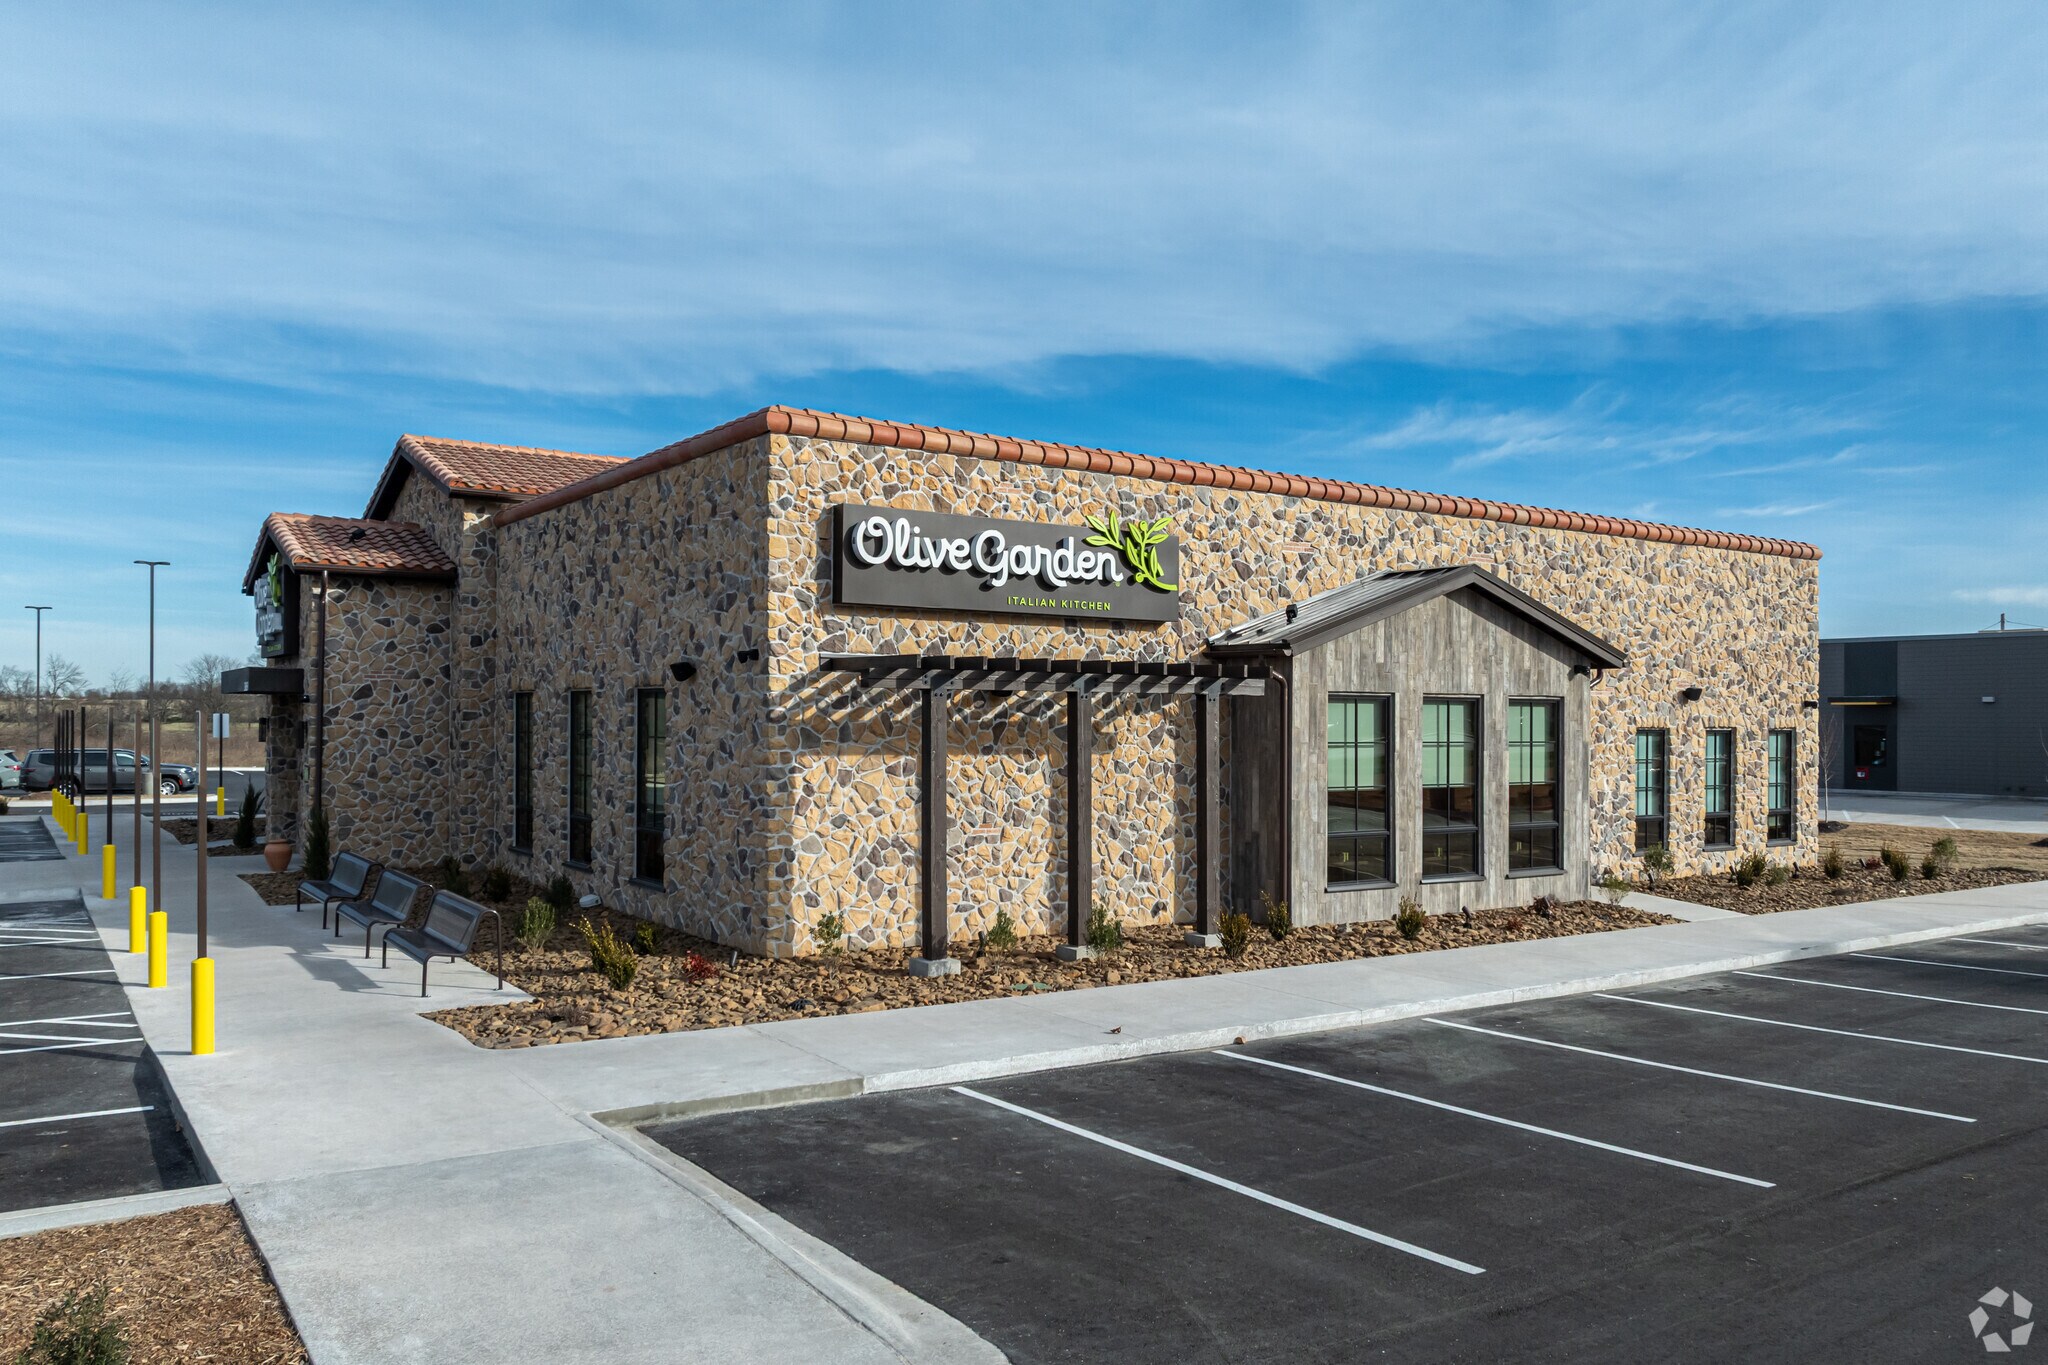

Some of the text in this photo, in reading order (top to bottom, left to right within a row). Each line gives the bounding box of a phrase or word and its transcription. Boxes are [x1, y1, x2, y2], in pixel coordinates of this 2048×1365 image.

[854, 515, 1124, 587] Olive Garden
[1007, 596, 1112, 611] ITALIAN KITCHEN
